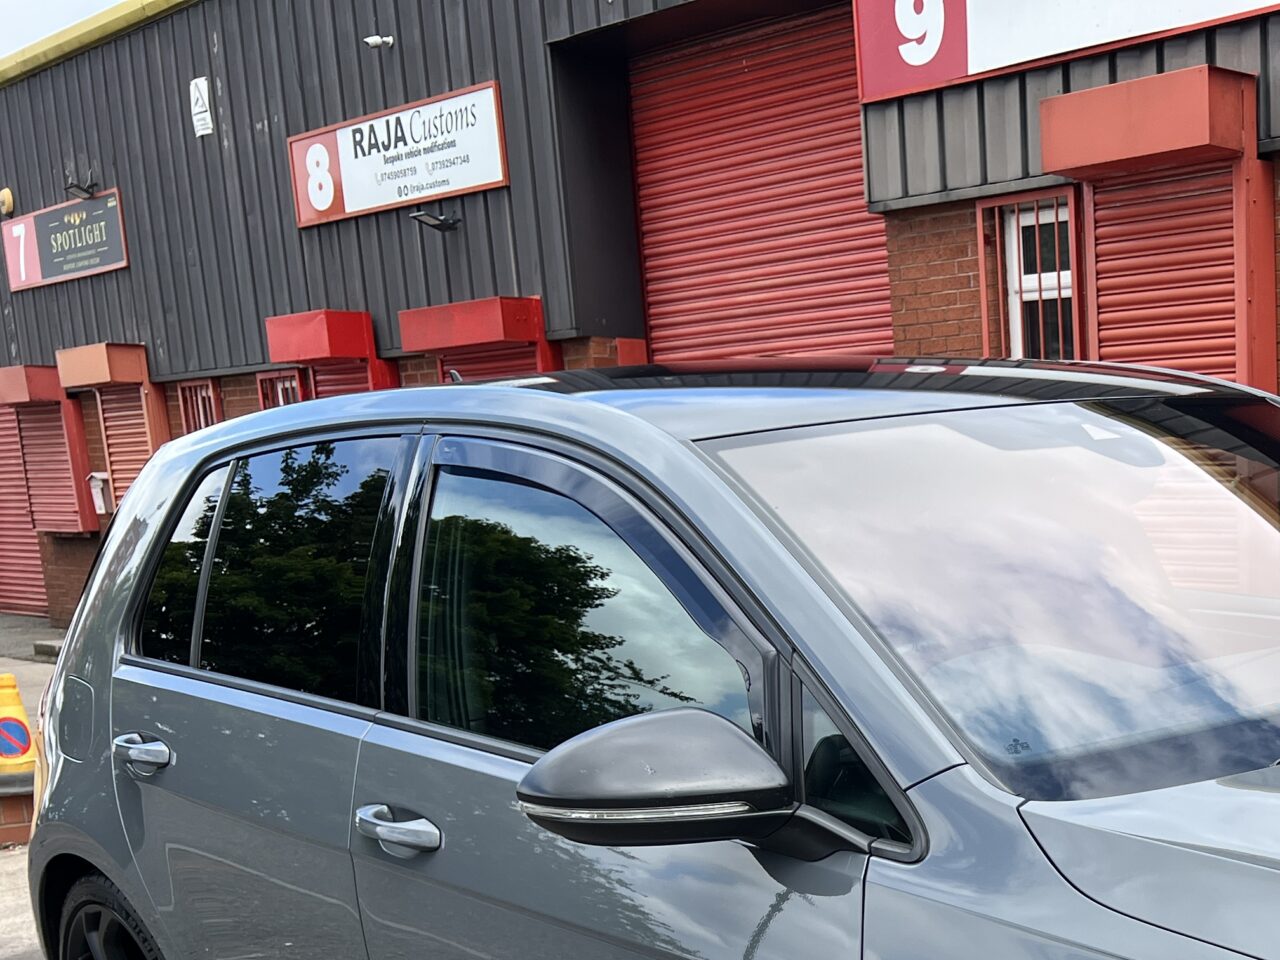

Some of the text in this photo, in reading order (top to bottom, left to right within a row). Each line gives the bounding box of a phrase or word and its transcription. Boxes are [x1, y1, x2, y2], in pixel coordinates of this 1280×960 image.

[894, 0, 945, 66] 9
[351, 103, 477, 159] RAJA Customs
[305, 143, 335, 211] 8
[12, 223, 26, 281] 7
[50, 221, 107, 253] SPOTLIGHT
